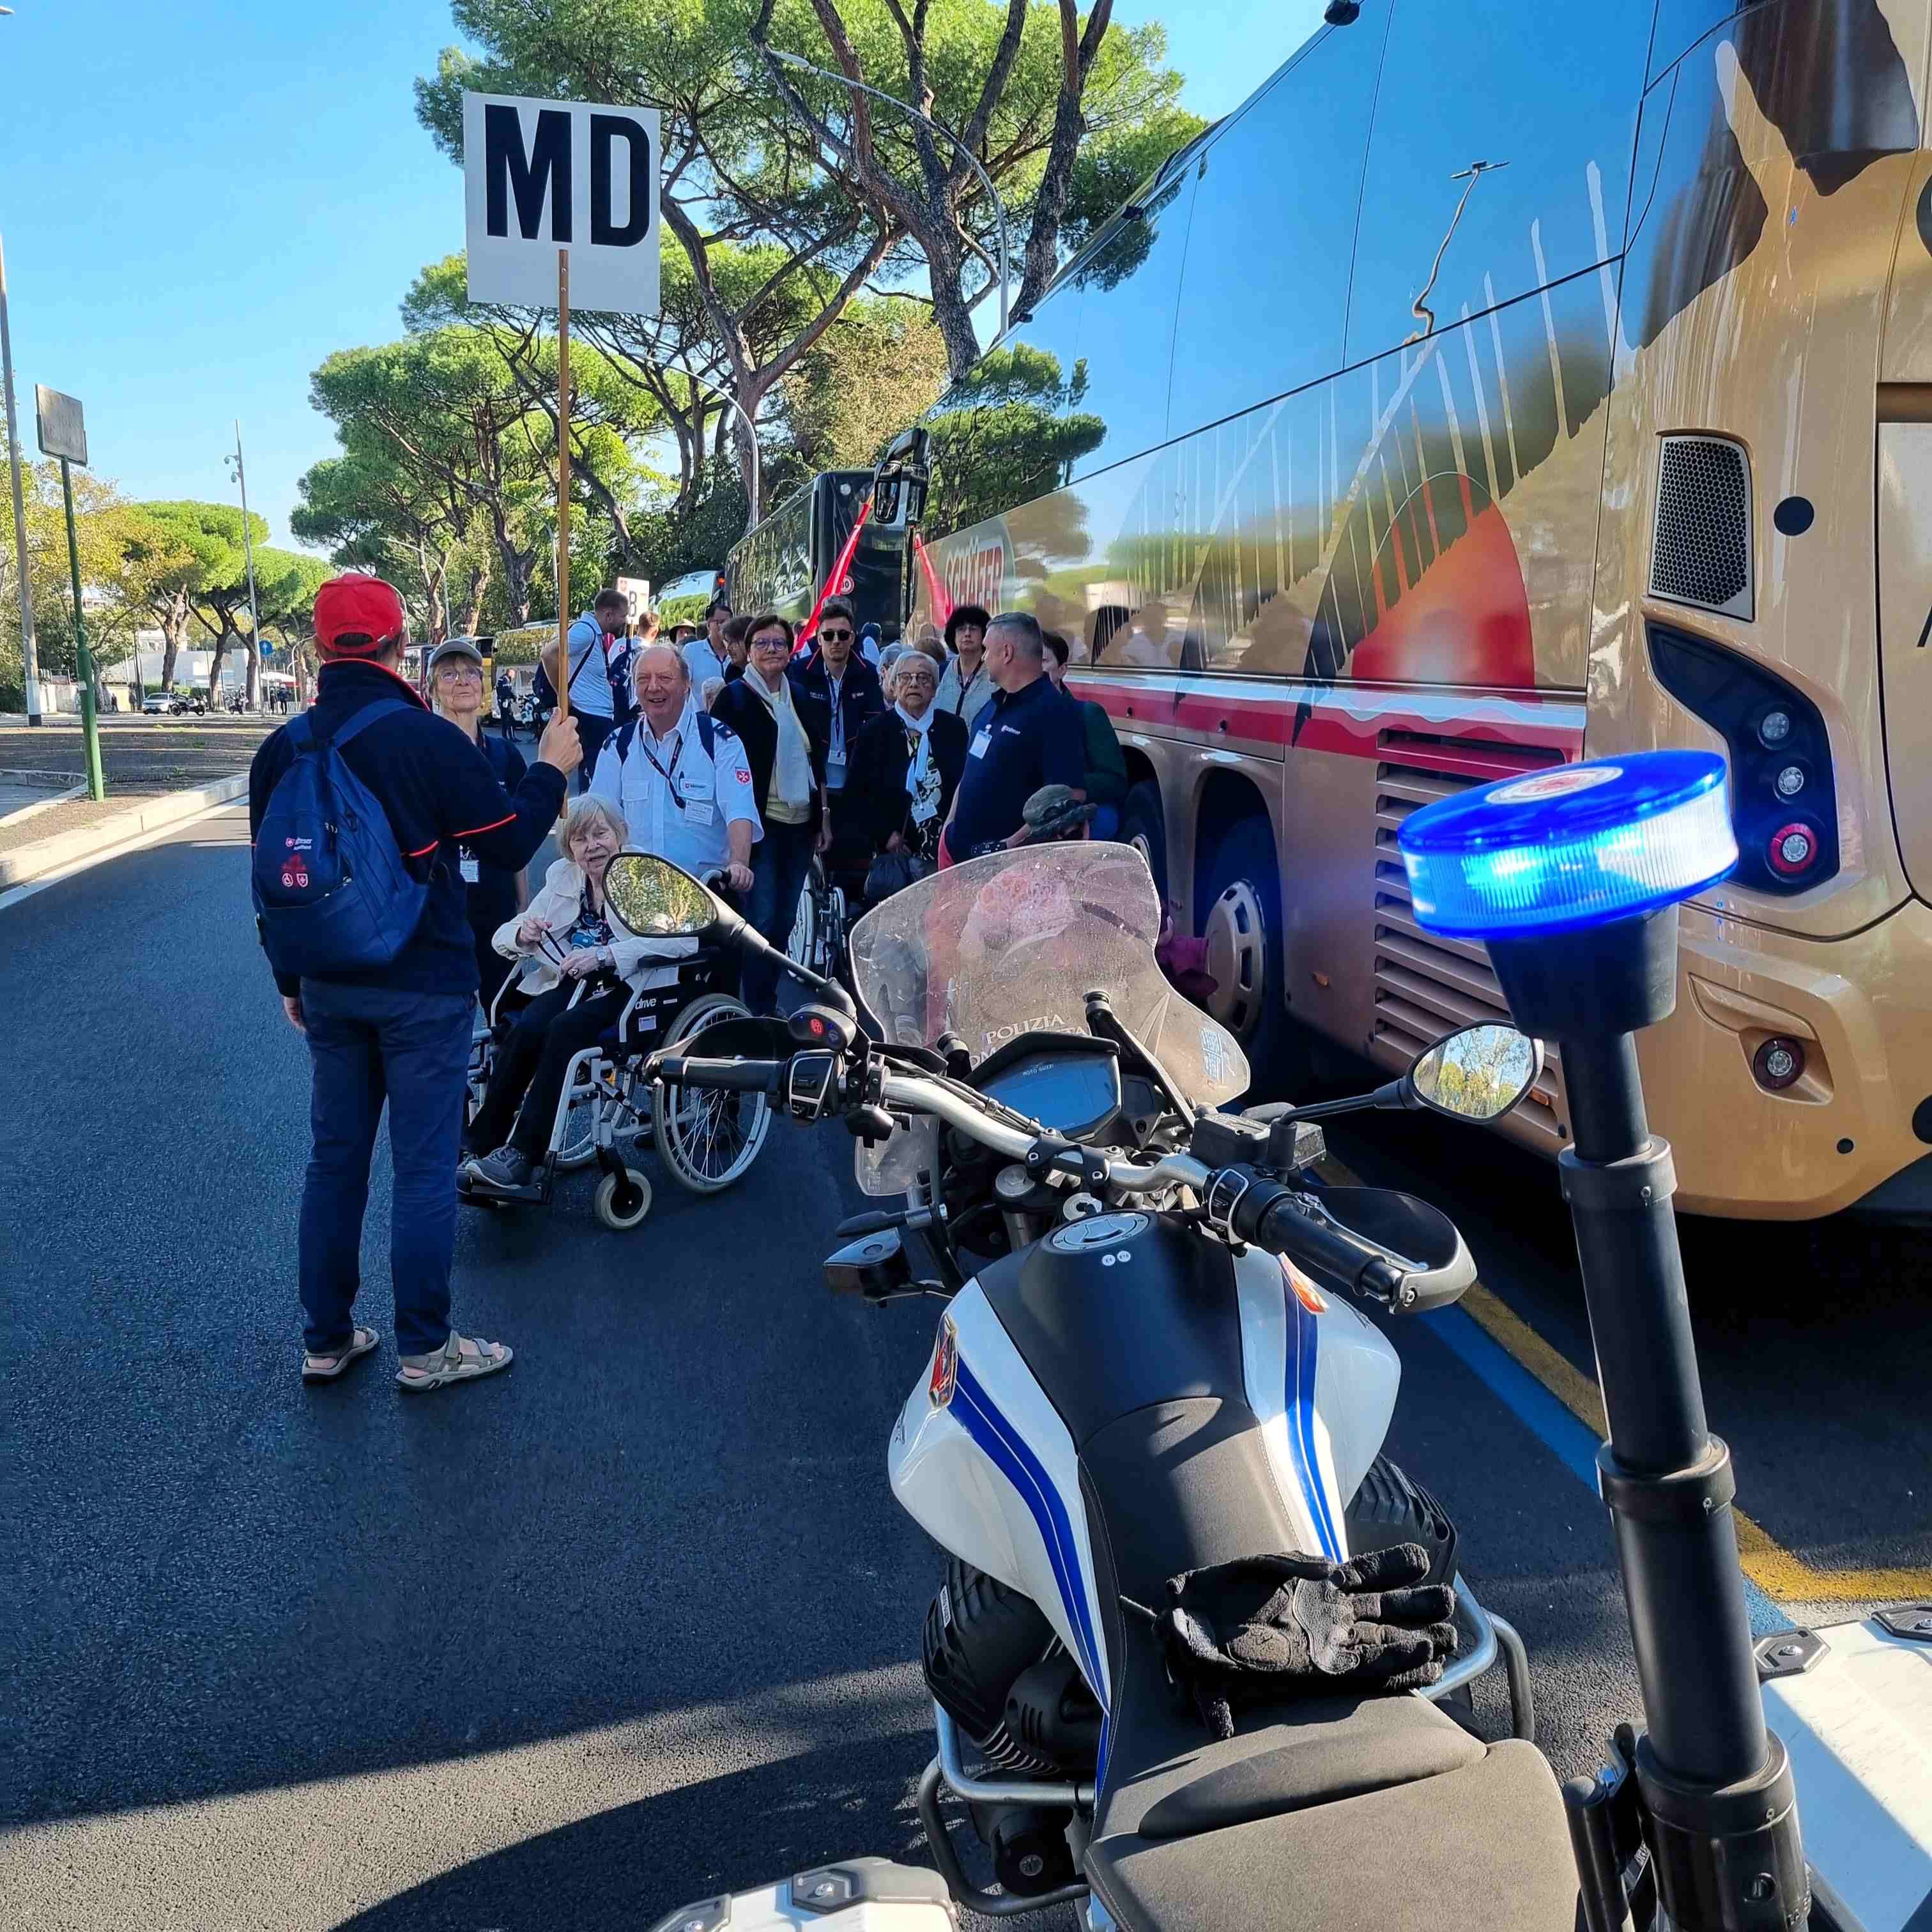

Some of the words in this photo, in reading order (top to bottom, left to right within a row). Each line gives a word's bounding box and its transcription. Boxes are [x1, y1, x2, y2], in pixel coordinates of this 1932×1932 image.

[485, 103, 650, 247] MD
[635, 997, 657, 1010] drive
[986, 1013, 1066, 1044] POLIZIA
